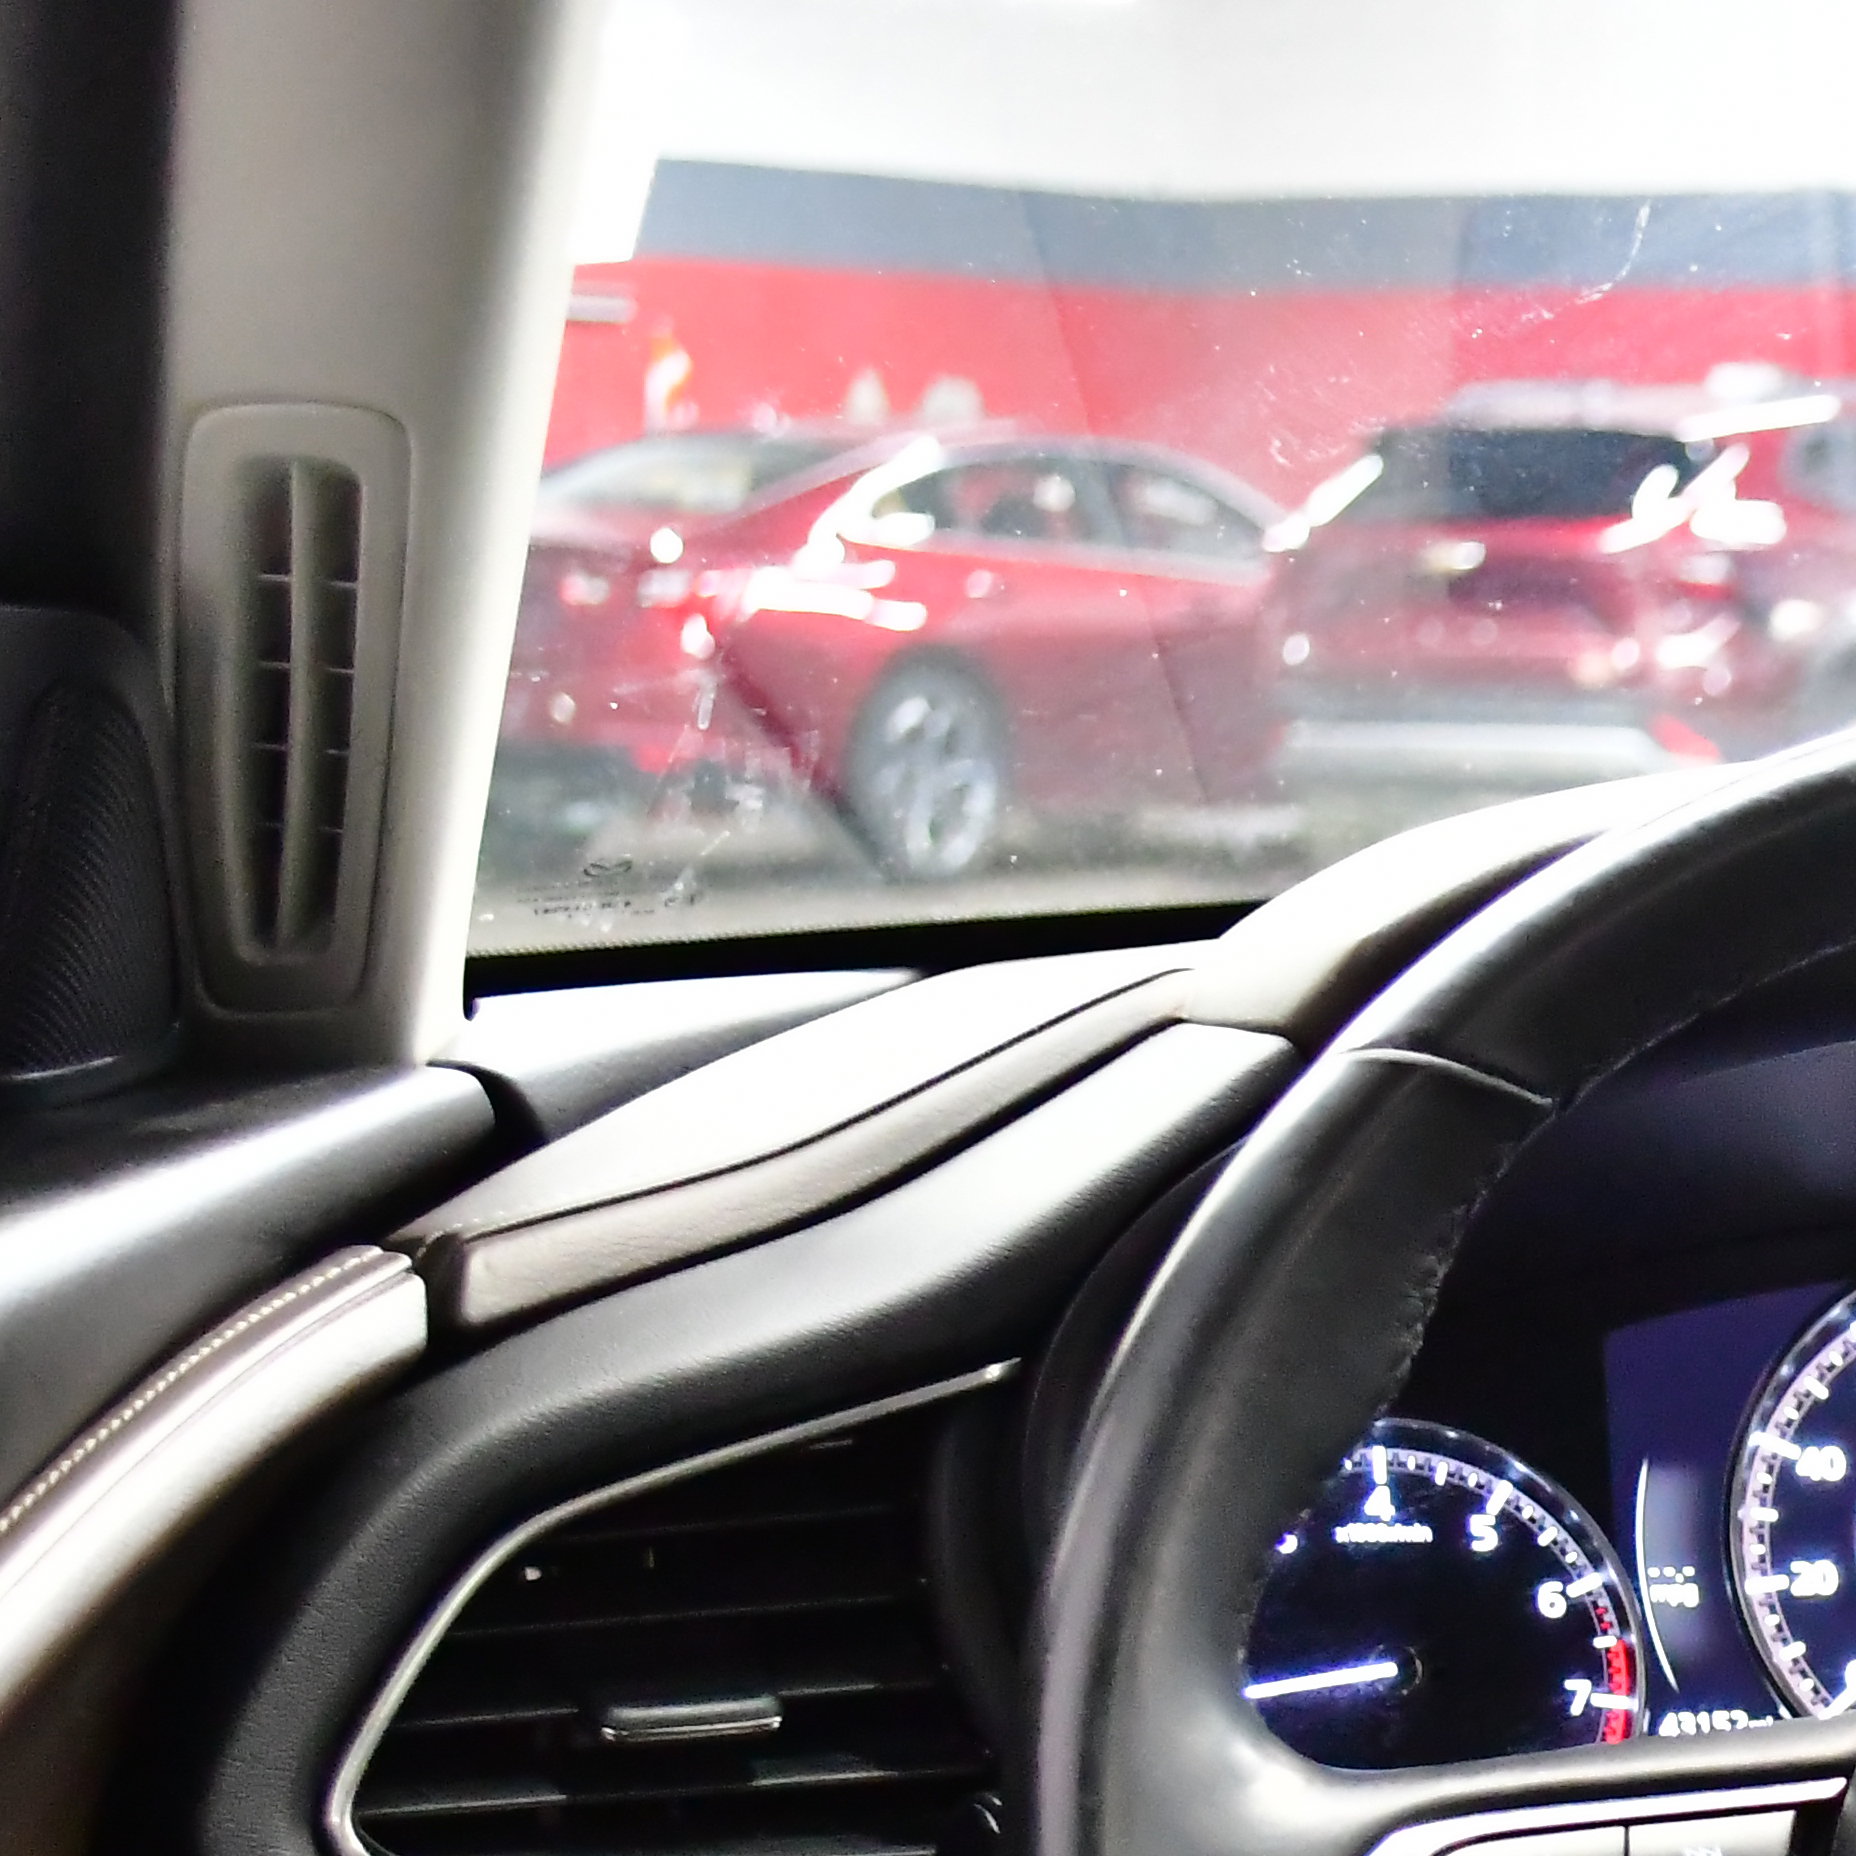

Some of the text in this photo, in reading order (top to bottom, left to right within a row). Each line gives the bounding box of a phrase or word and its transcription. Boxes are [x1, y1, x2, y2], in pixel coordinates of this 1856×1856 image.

[1795, 1446, 1847, 1482] 40
[1364, 1485, 1396, 1521] 4
[1468, 1514, 1499, 1552] 5
[1790, 1559, 1839, 1597] 20
[1536, 1580, 1567, 1619] 6
[1563, 1678, 1592, 1716] 7
